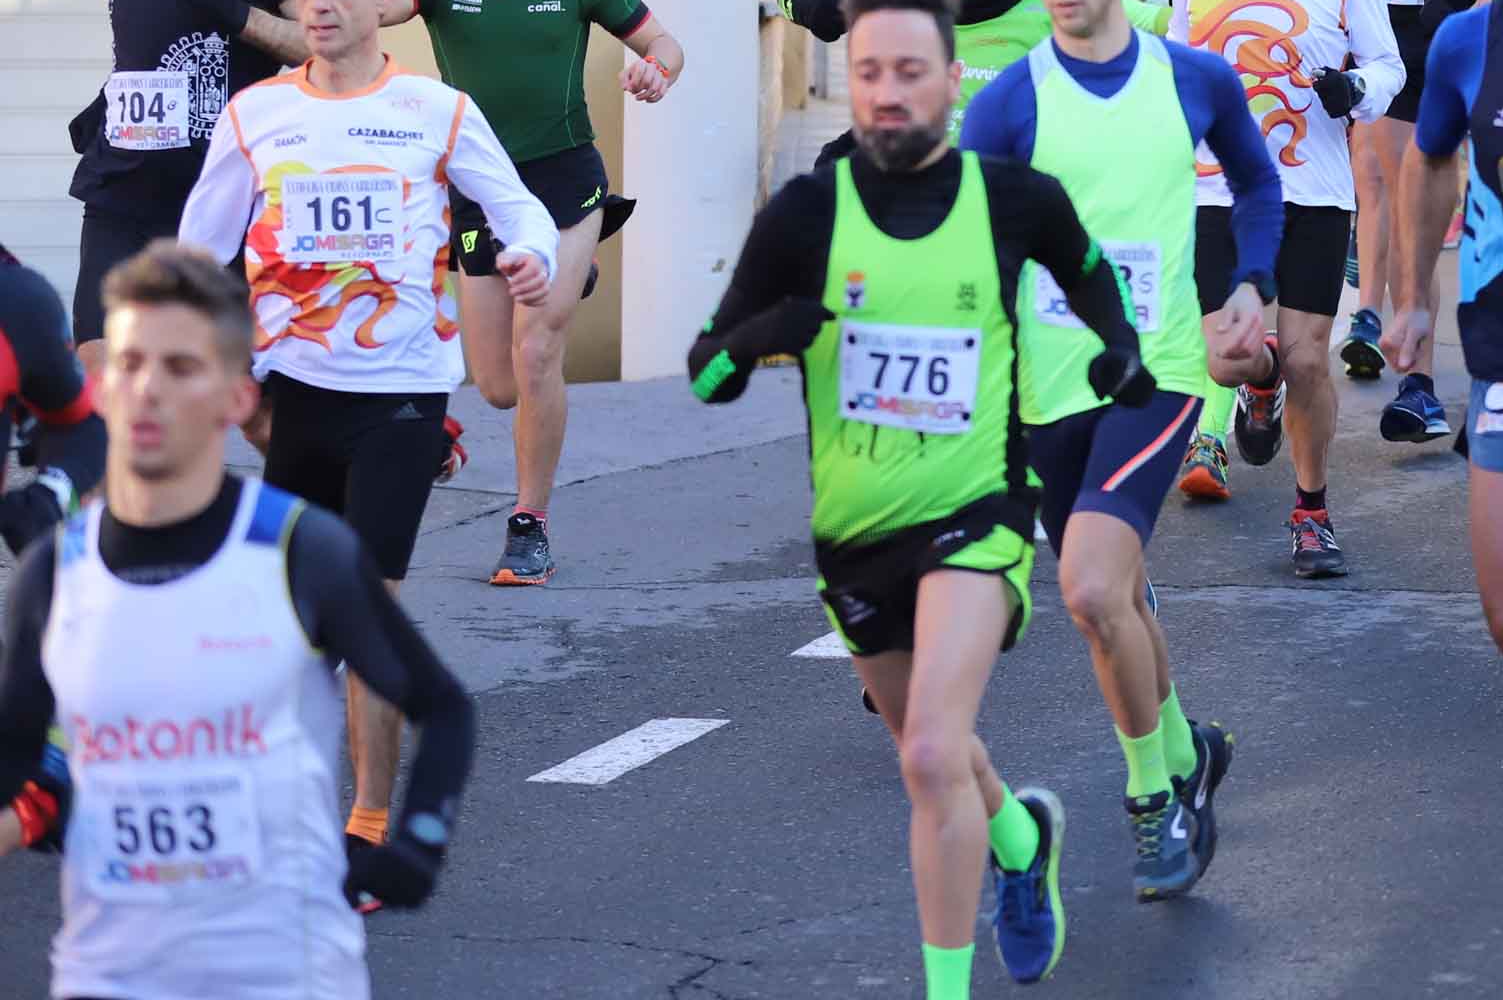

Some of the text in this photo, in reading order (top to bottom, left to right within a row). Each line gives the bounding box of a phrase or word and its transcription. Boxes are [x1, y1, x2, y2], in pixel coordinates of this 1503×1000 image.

[117, 91, 167, 124] 104
[111, 125, 180, 141] OMISAGA
[306, 195, 373, 232] 161
[869, 351, 950, 396] 776
[113, 804, 216, 855] 563
